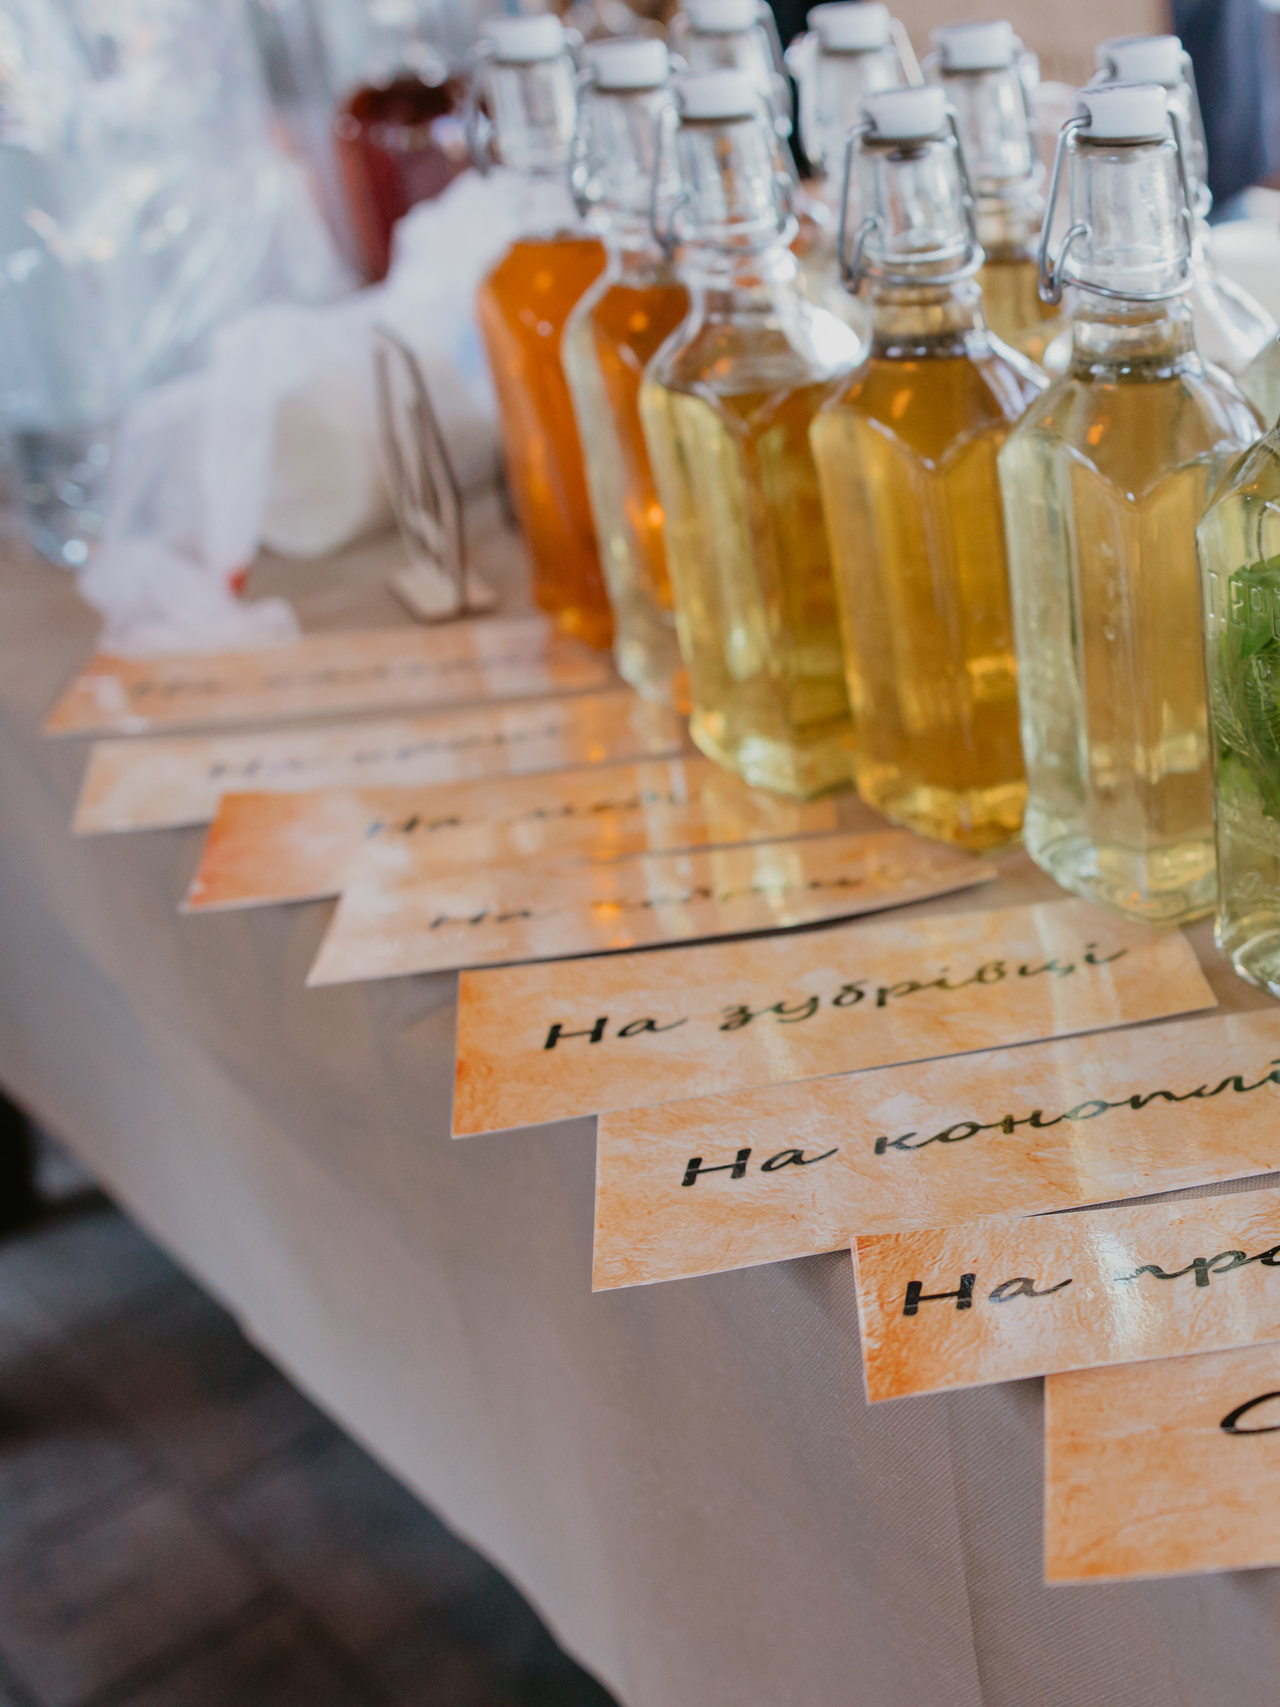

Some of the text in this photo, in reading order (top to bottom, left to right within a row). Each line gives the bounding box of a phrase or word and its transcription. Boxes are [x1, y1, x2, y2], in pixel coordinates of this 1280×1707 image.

[543, 941, 1129, 1051] На зубрівці
[681, 1146, 839, 1188] На
[902, 1272, 1074, 1318] На
